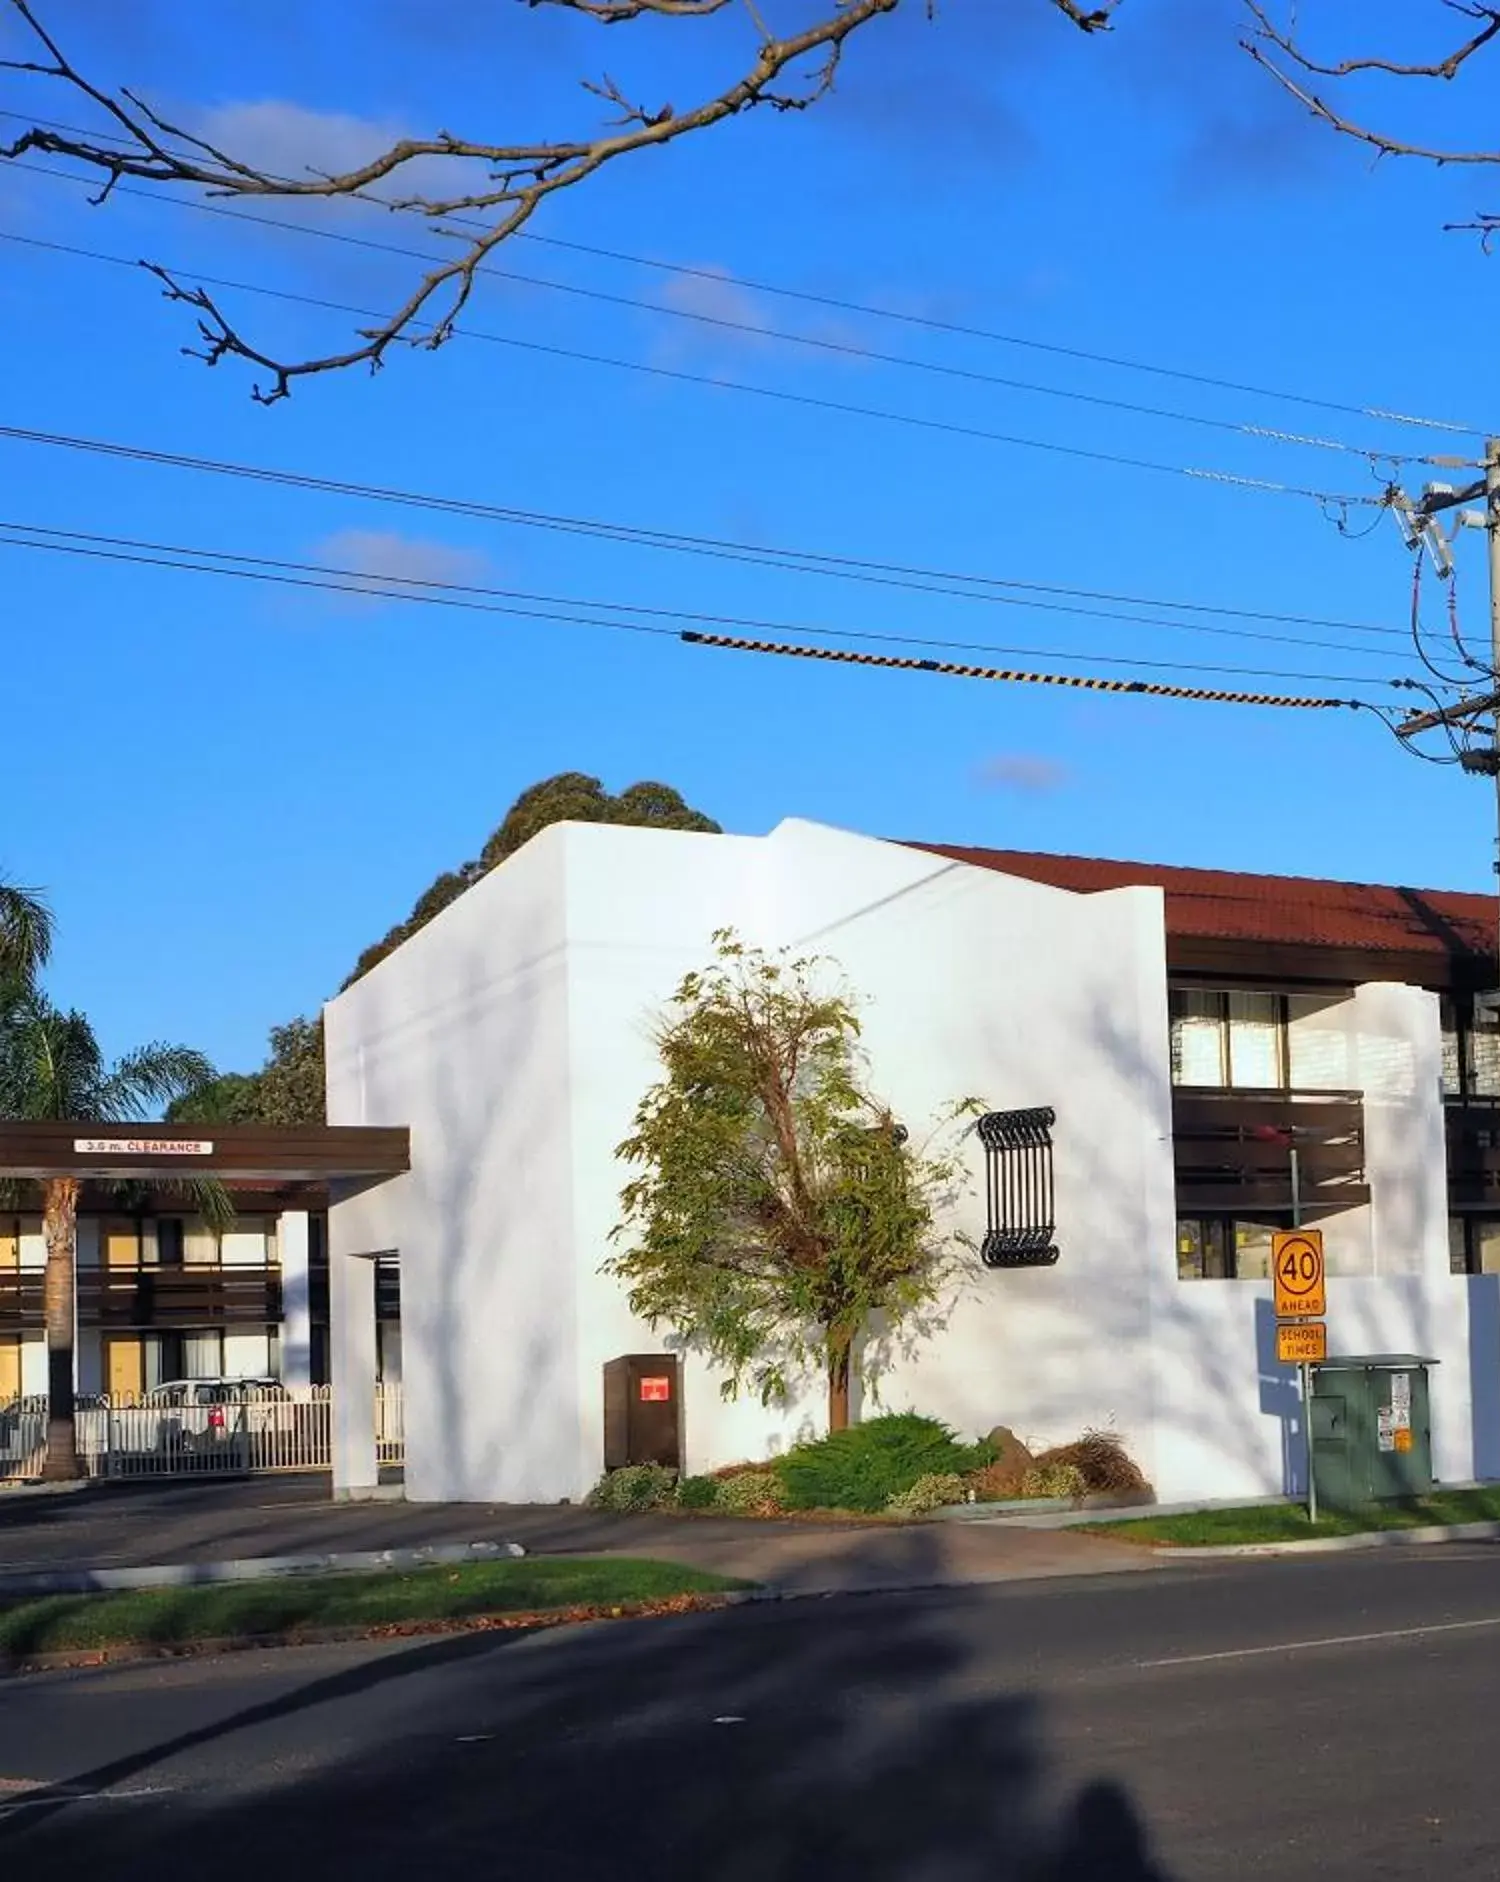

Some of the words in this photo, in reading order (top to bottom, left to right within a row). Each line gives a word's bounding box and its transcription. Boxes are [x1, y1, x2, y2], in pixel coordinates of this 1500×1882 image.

[127, 1141, 202, 1153] CLEARANCE
[1282, 1252, 1315, 1281] 40
[1281, 1299, 1320, 1311] AHEAD
[1280, 1329, 1321, 1341] SCHOOL
[1285, 1343, 1318, 1355] TIMES
